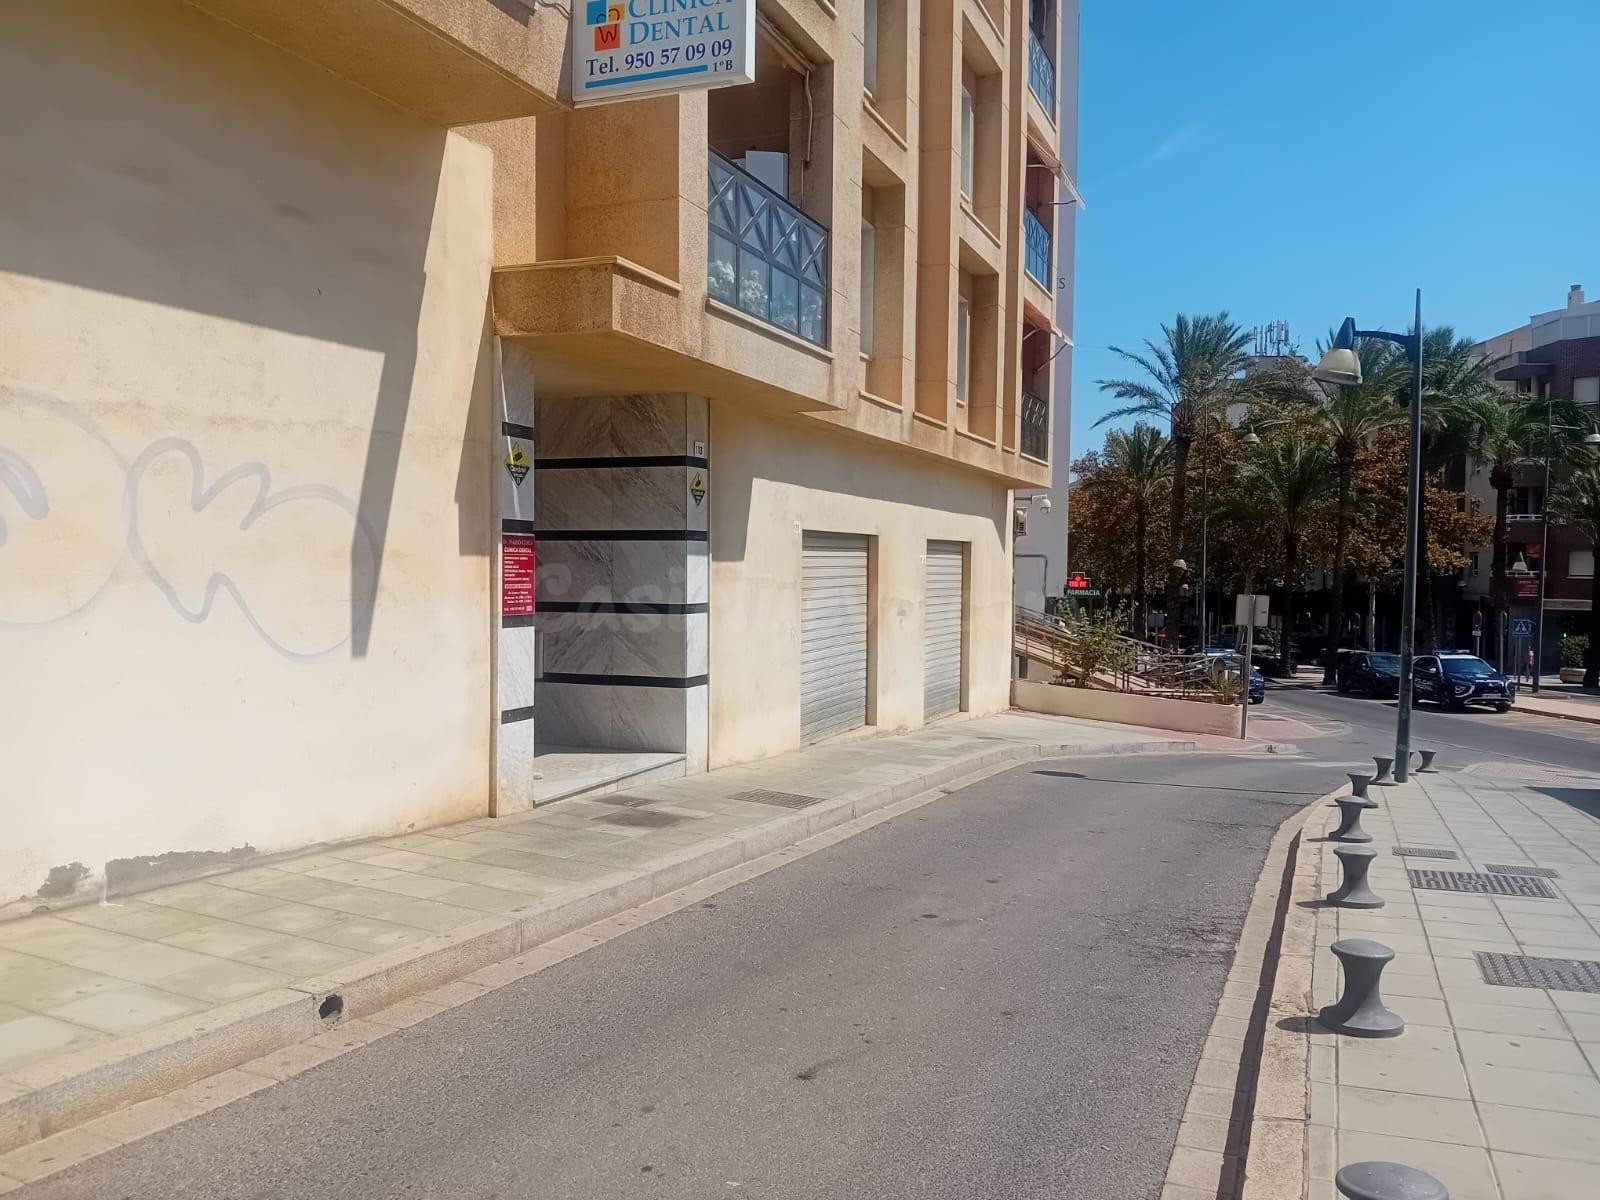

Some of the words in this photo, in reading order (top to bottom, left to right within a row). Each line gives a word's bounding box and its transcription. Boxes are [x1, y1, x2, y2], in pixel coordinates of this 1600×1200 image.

[628, 0, 733, 18] CLIN
[628, 11, 730, 45] DENTAL
[585, 56, 620, 76] Tel.
[625, 50, 655, 71] 950
[660, 46, 681, 65] 57
[685, 42, 706, 61] 09
[711, 38, 732, 57] 09
